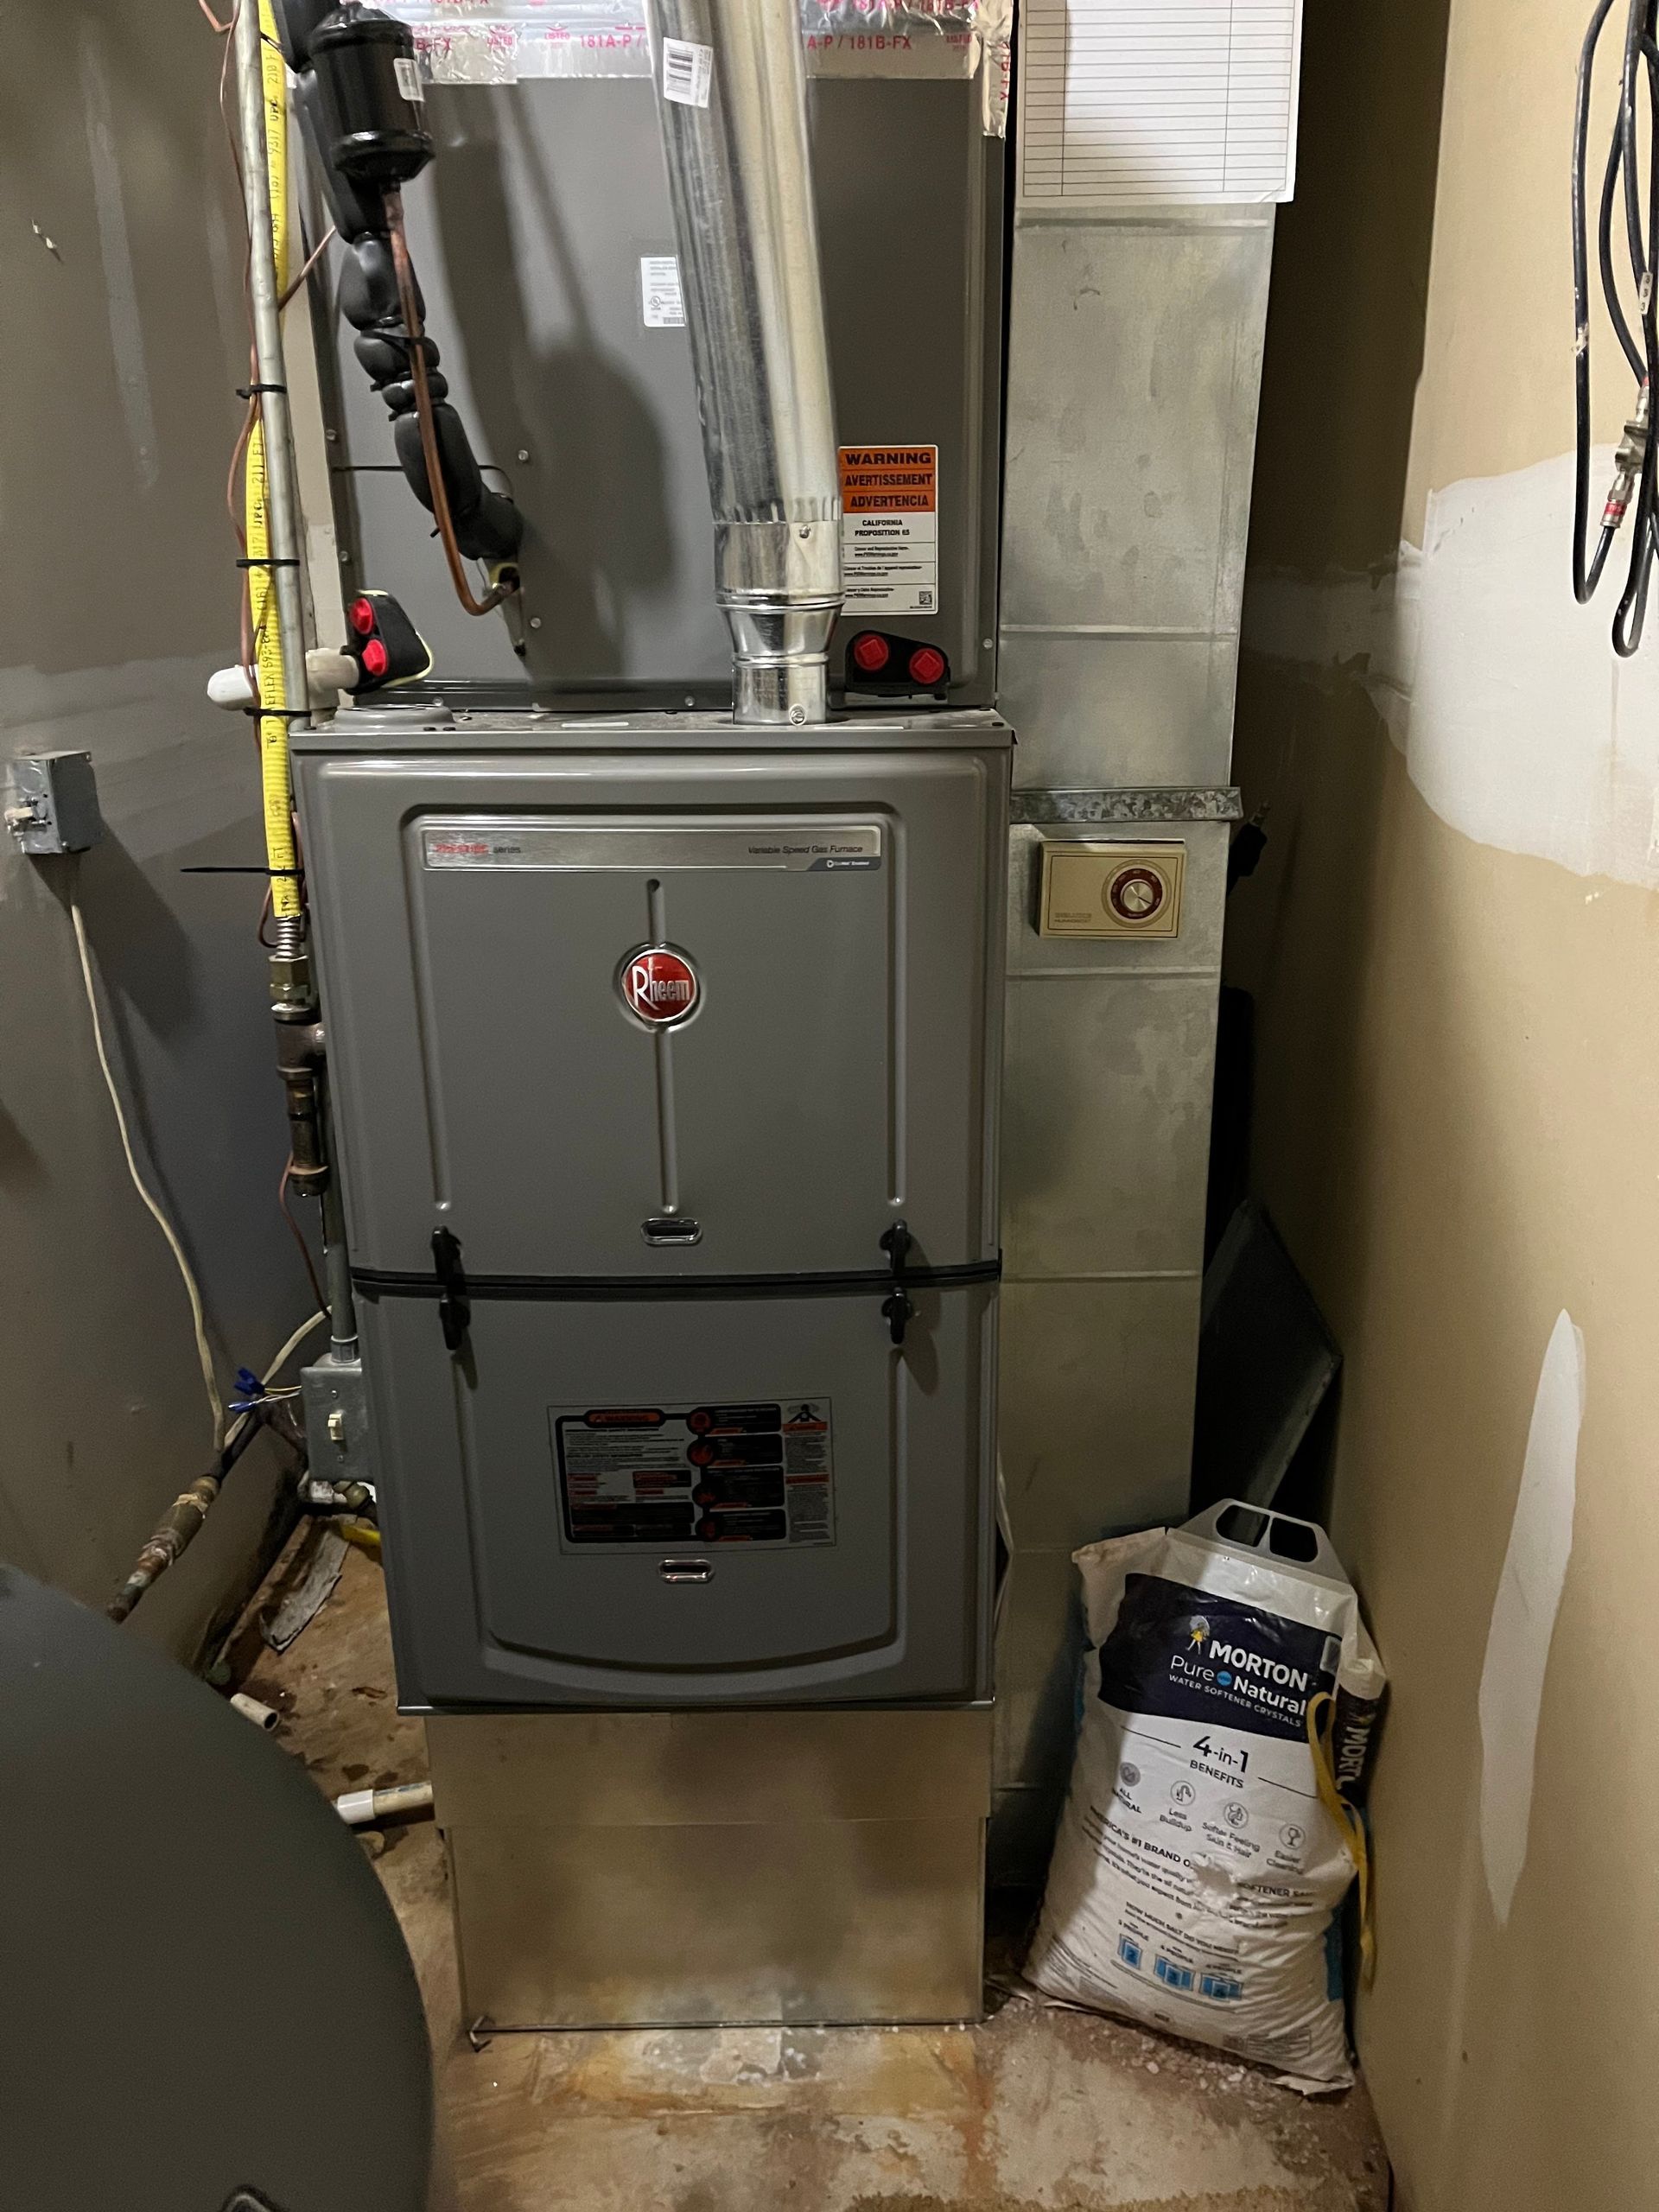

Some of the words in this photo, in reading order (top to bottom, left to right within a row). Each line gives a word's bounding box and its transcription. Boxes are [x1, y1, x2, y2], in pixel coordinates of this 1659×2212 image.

[581, 35, 632, 48] 181A-P
[807, 35, 833, 50] A-P
[850, 35, 912, 50] 181B-FX
[845, 452, 931, 465] WARNING
[845, 474, 932, 486] AVERTISSEMENT
[850, 495, 929, 507] ADVERTENCIA
[782, 845, 810, 855] Speed
[811, 845, 828, 854] Gas
[830, 845, 863, 854] Furnace
[632, 957, 690, 1011] Rheem
[1210, 1640, 1308, 1692] MORTON
[1170, 1655, 1215, 1682] Pure
[1233, 1675, 1306, 1716] Natural
[1169, 1674, 1202, 1690] WATER
[1204, 1685, 1252, 1709] SOFTENER
[1254, 1703, 1303, 1727] CRYSTALS
[1192, 1735, 1249, 1773] 4-in-1
[1190, 1759, 1245, 1789] BENEFITS
[1160, 1814, 1192, 1832] Buildup
[1169, 1808, 1187, 1820] Less
[1229, 1830, 1261, 1853] Feeling
[1143, 1841, 1181, 1863] BRAND
